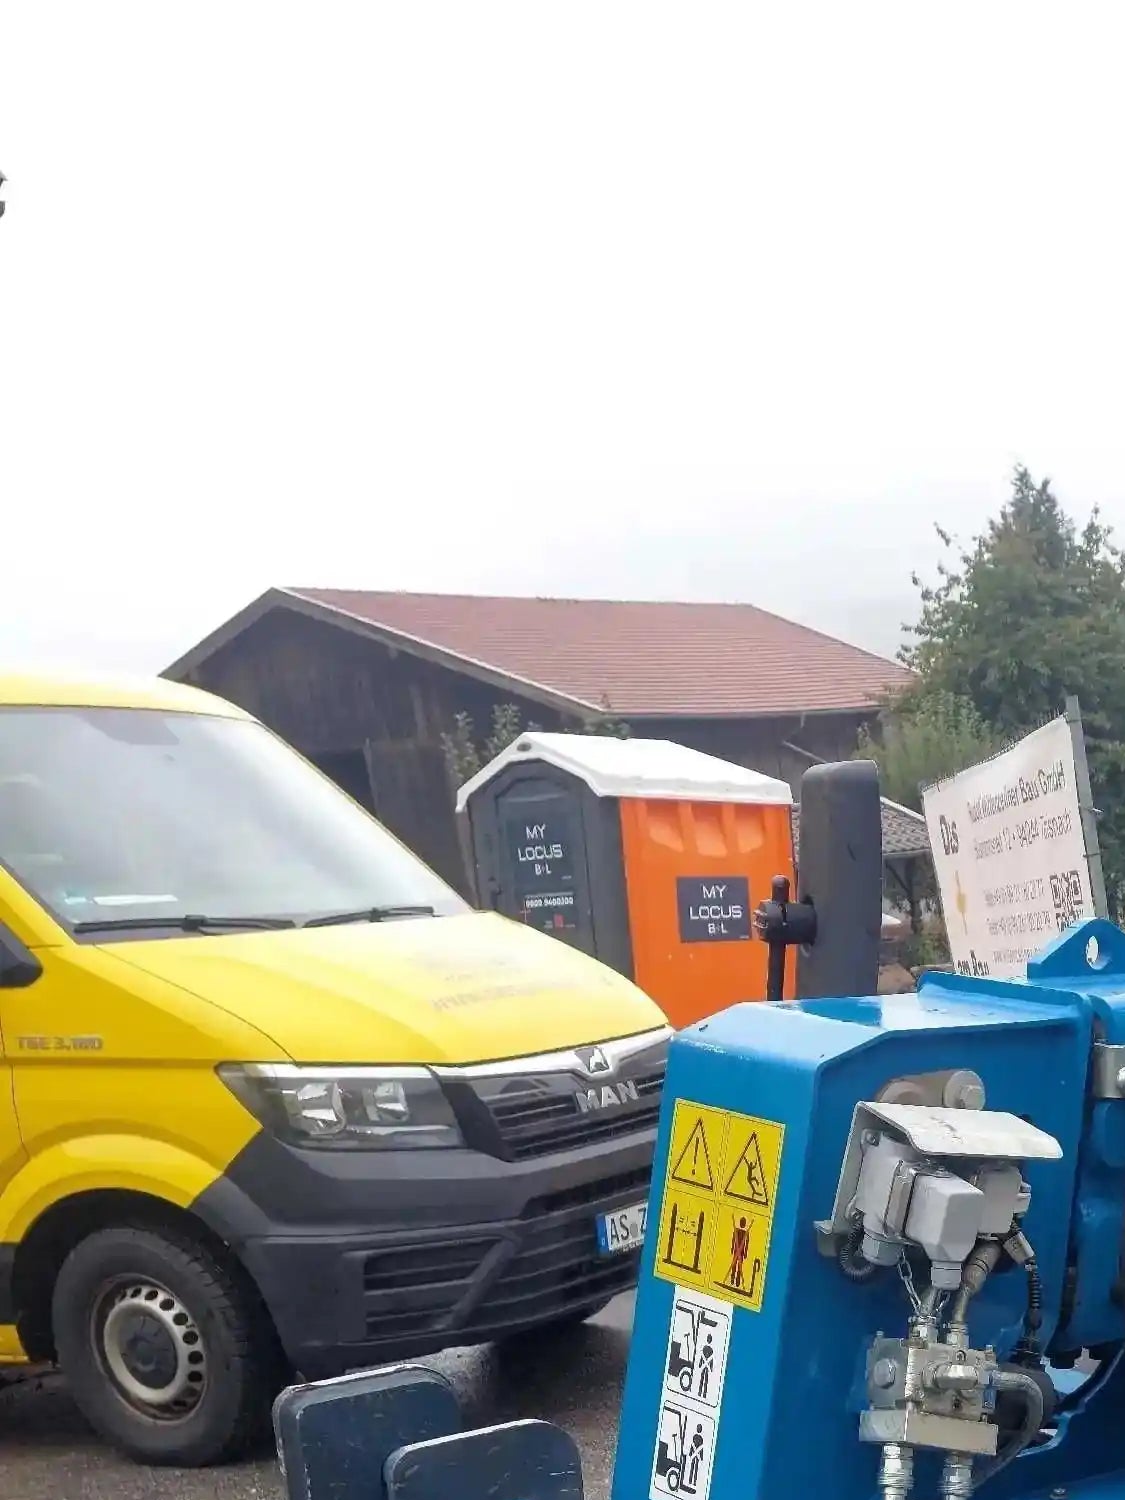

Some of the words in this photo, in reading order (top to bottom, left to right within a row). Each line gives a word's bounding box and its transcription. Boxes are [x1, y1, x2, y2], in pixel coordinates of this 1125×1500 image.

[1038, 760, 1067, 795] GmbH
[525, 824, 546, 840] MY
[517, 843, 563, 861] LOCUS
[702, 884, 727, 899] MY
[689, 905, 743, 920] LOCUS
[576, 1080, 639, 1113] MAN
[610, 1214, 630, 1245] AS
